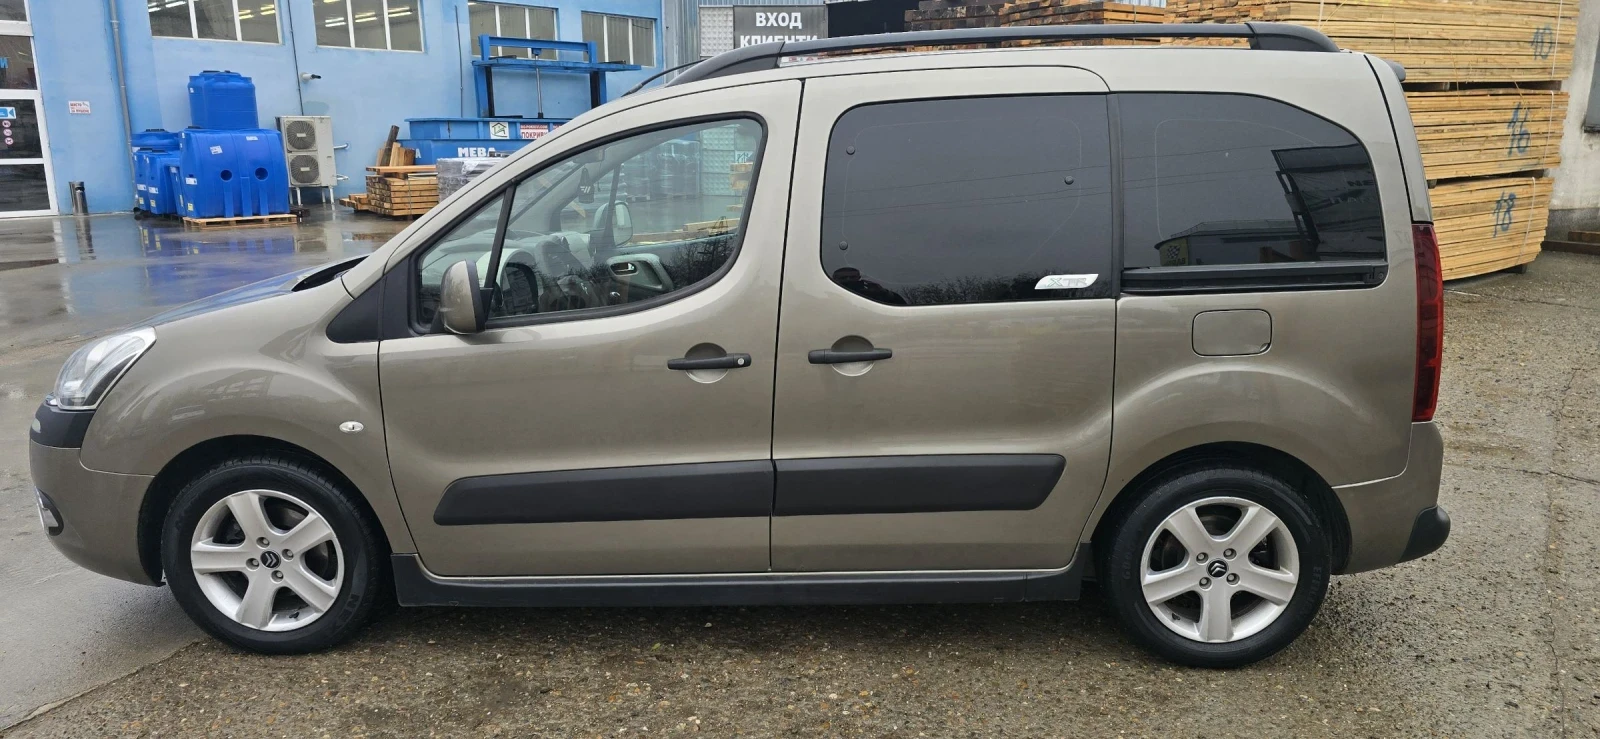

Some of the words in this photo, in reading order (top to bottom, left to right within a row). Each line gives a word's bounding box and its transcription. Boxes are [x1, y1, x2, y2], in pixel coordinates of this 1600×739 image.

[755, 12, 802, 29] ВХОД
[1530, 25, 1553, 61] 10
[1507, 101, 1531, 158] 16
[1493, 191, 1516, 238] 18
[1047, 277, 1087, 287] XTR
